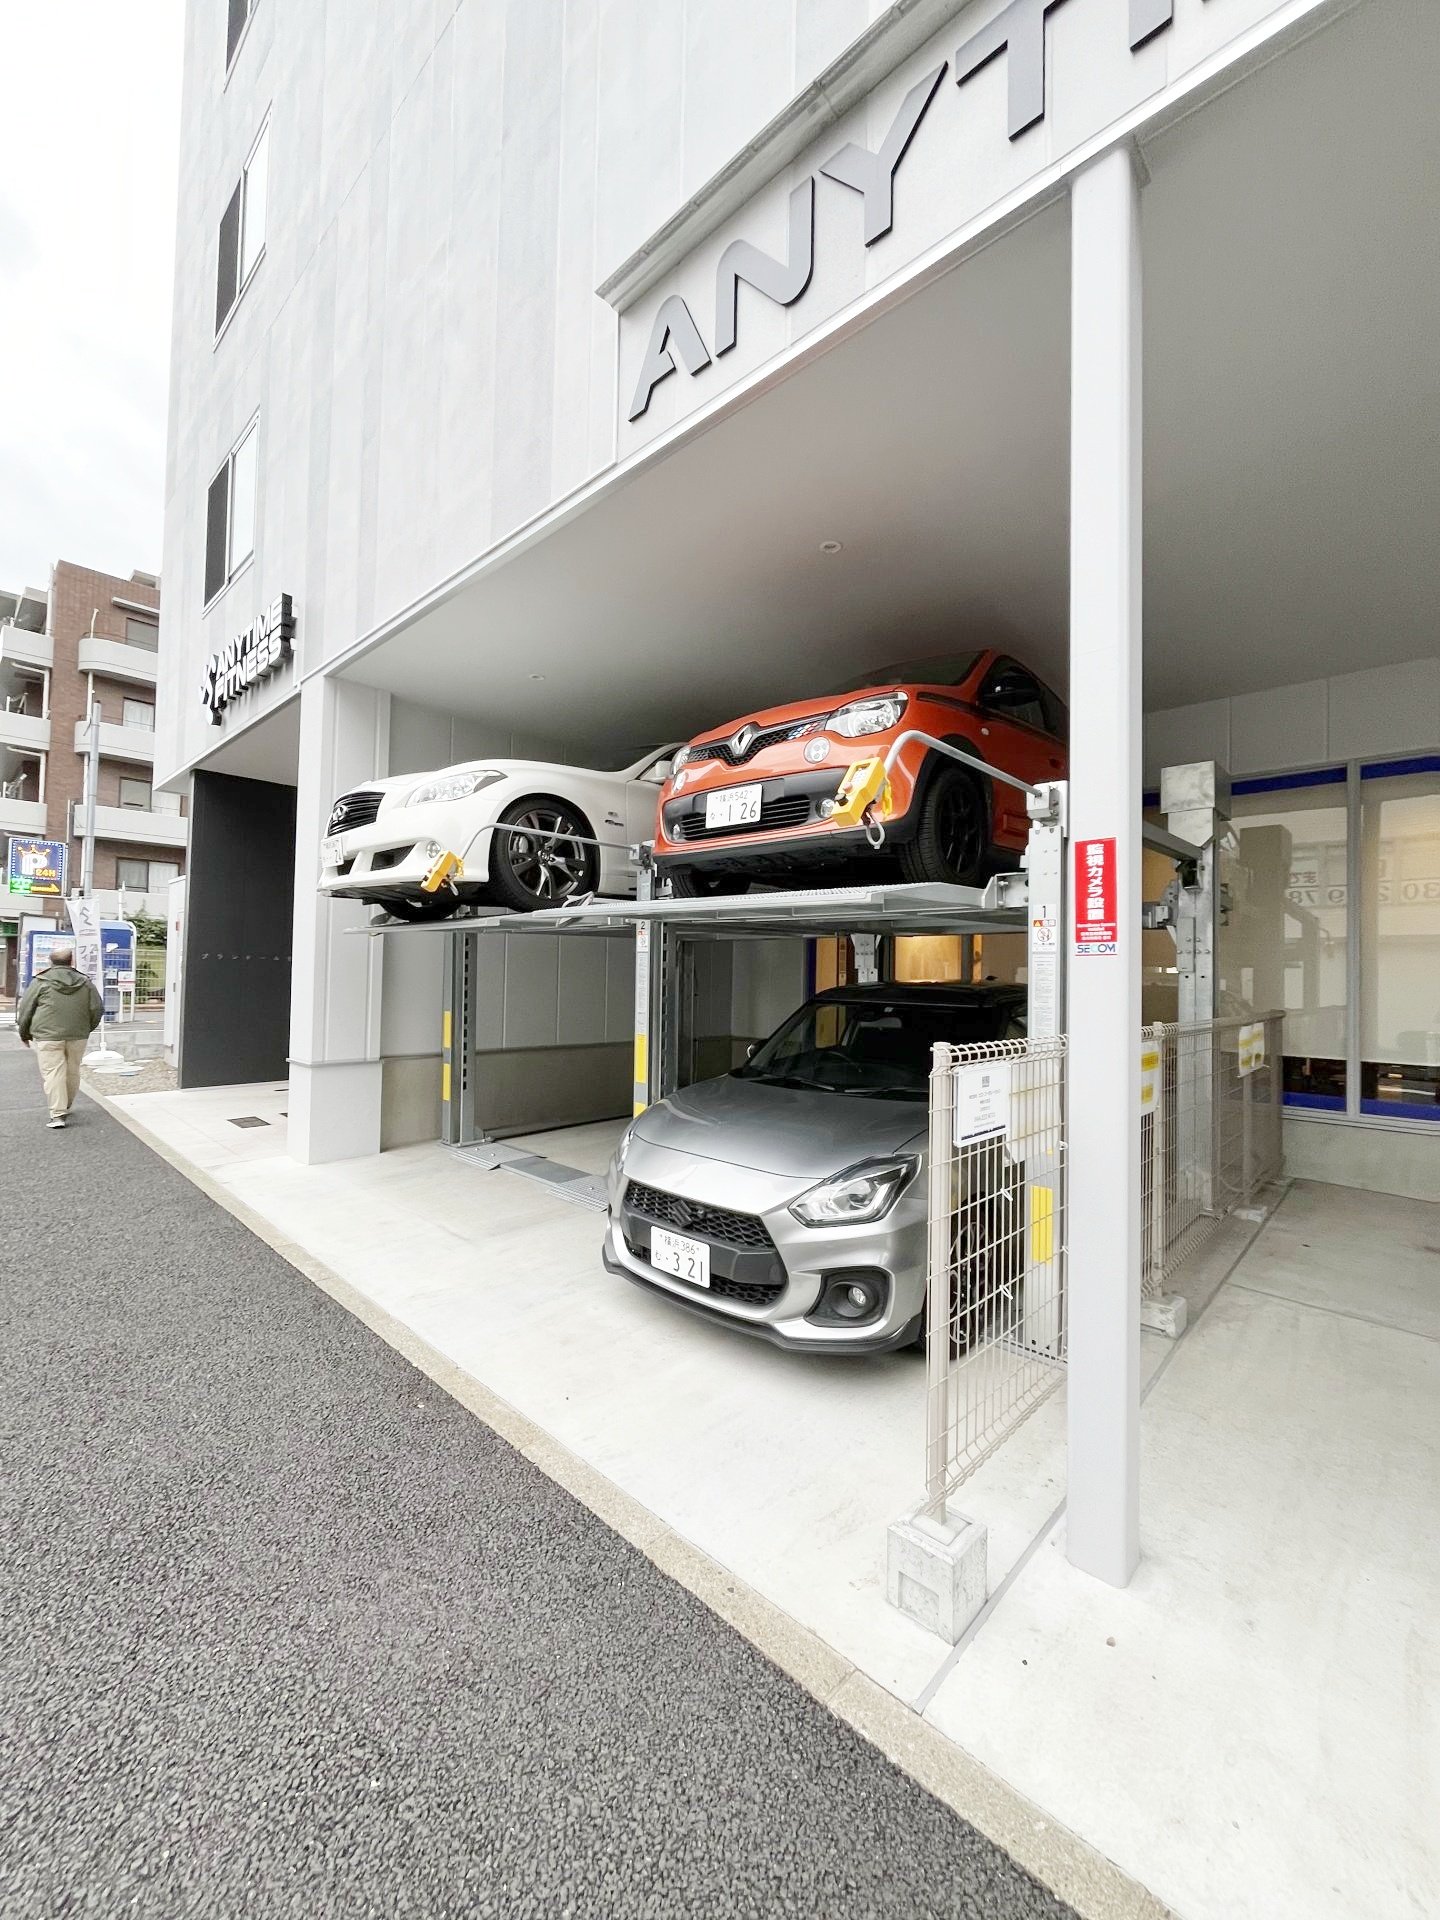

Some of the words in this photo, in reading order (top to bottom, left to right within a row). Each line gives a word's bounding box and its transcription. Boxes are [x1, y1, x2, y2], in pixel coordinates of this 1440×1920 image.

[629, 0, 1173, 423] ANYT
[216, 593, 290, 677] ANYTIME
[214, 625, 290, 709] FITNESS
[640, 921, 646, 931] 2
[1042, 905, 1047, 919] 1
[1077, 943, 1116, 954] SECOM
